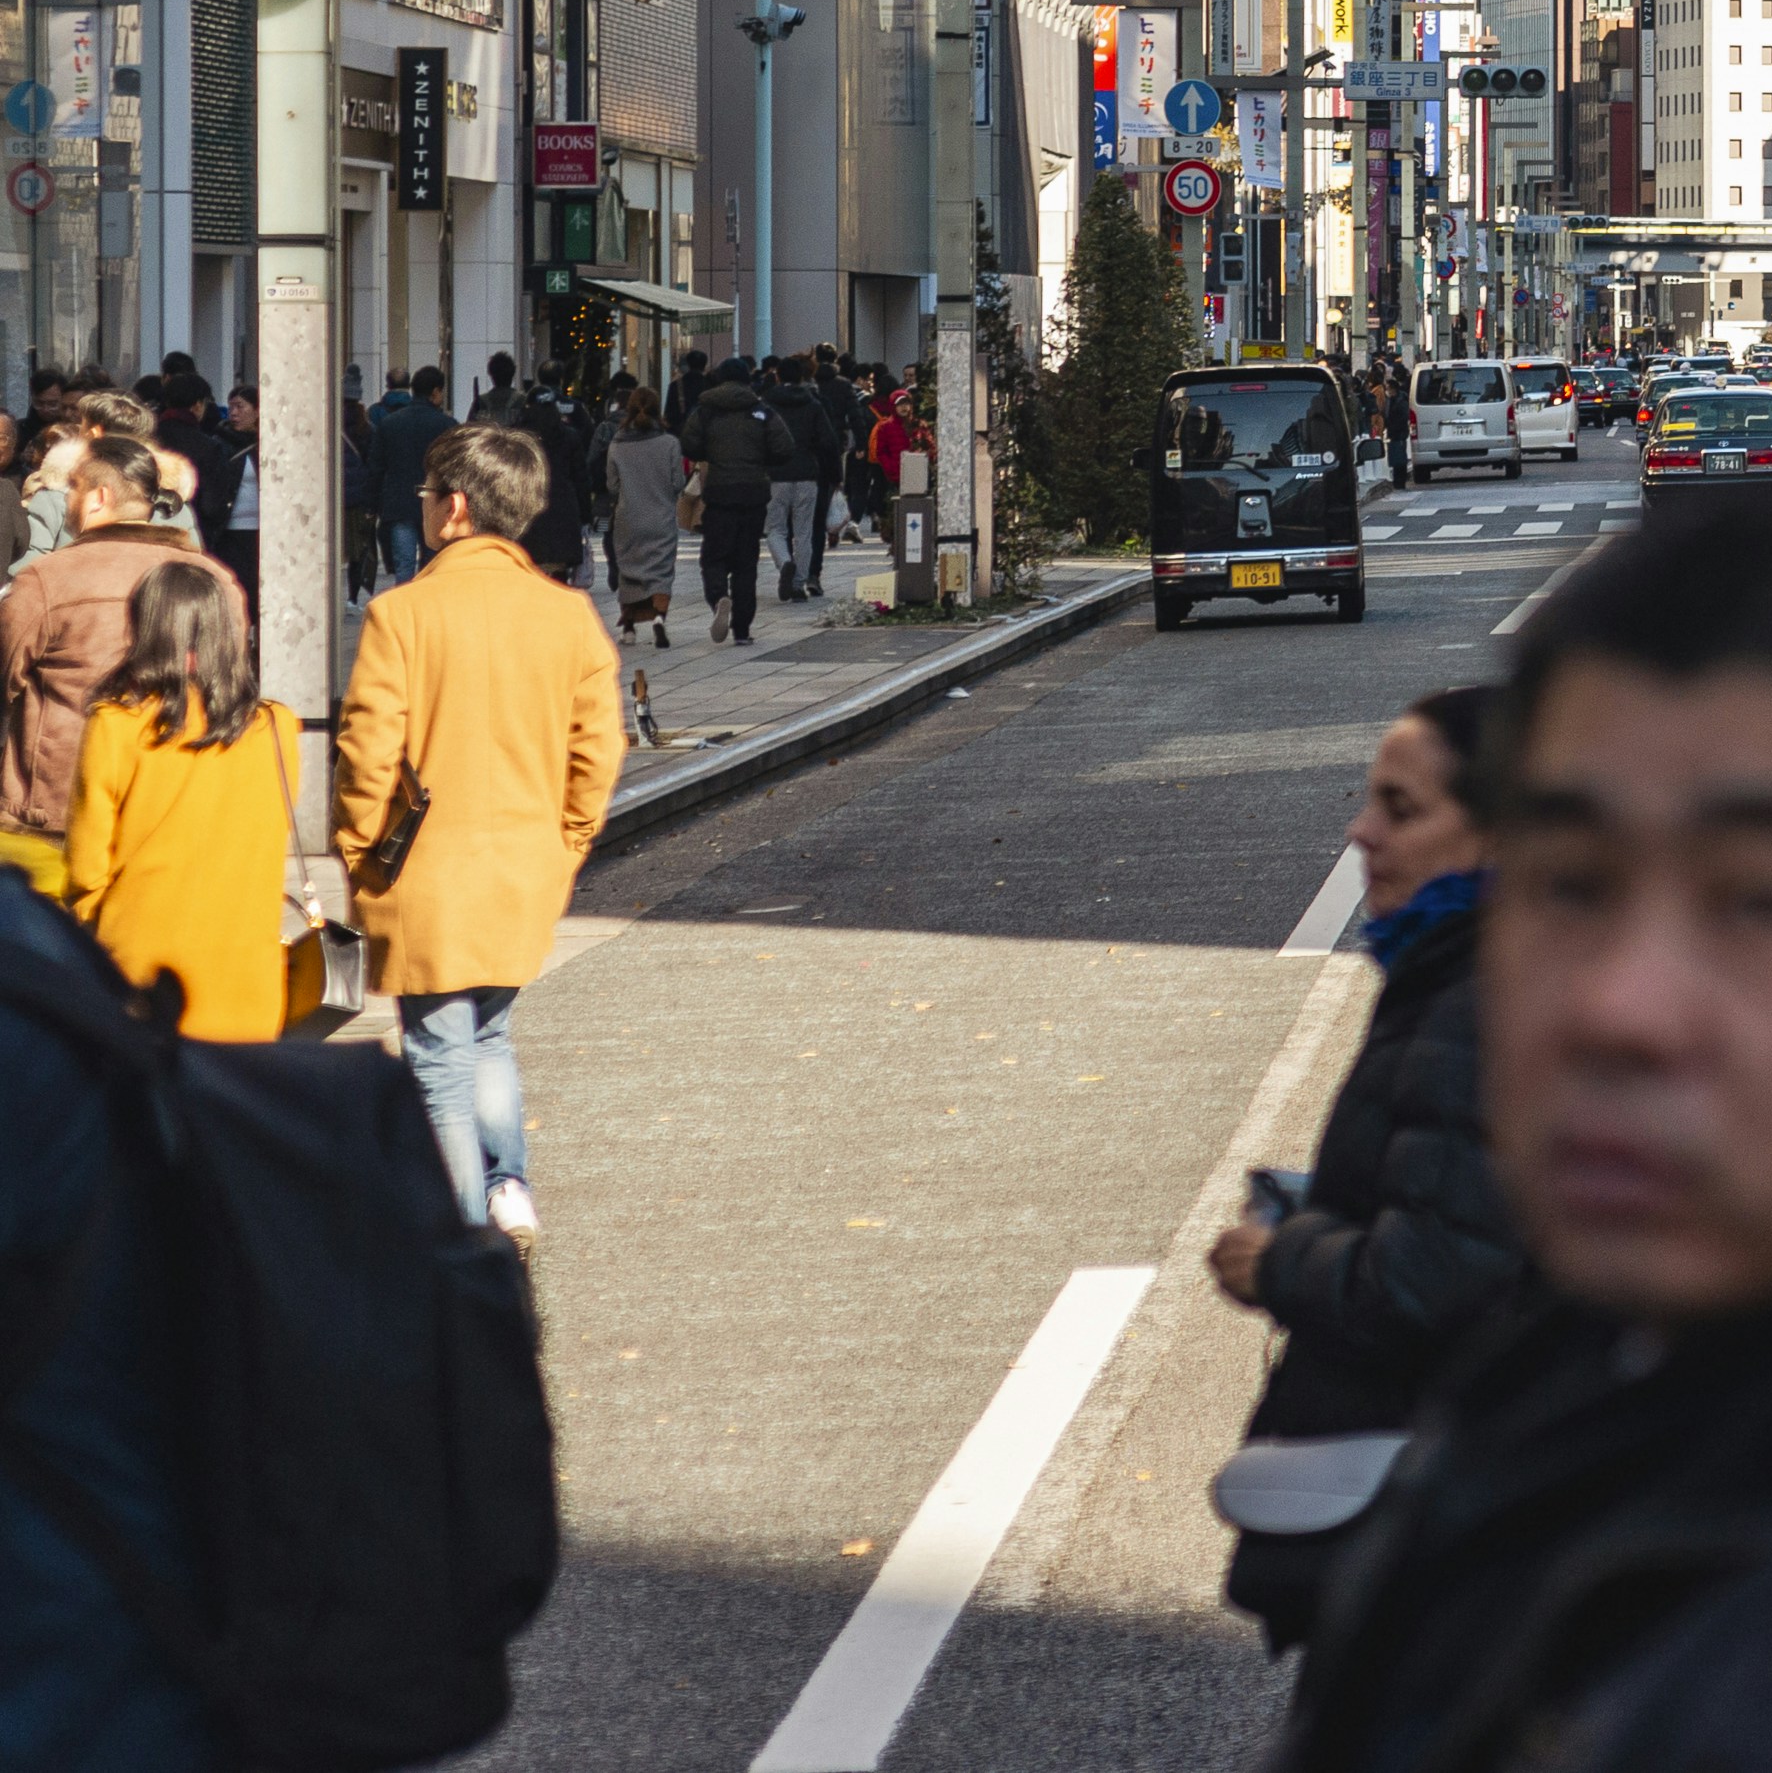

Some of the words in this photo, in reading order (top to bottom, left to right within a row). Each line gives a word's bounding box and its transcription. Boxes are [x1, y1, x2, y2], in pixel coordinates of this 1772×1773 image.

[1138, 17, 1156, 116] ヒカリミチ
[1350, 71, 1438, 87] 銀座三丁目
[1375, 87, 1401, 97] Ginza
[1404, 88, 1412, 97] 3
[414, 80, 430, 181] ZENITH
[1252, 96, 1267, 173] ヒカリミチ
[537, 135, 595, 151] BOOKS
[1172, 140, 1214, 155] 8-20
[1177, 176, 1209, 200] 50
